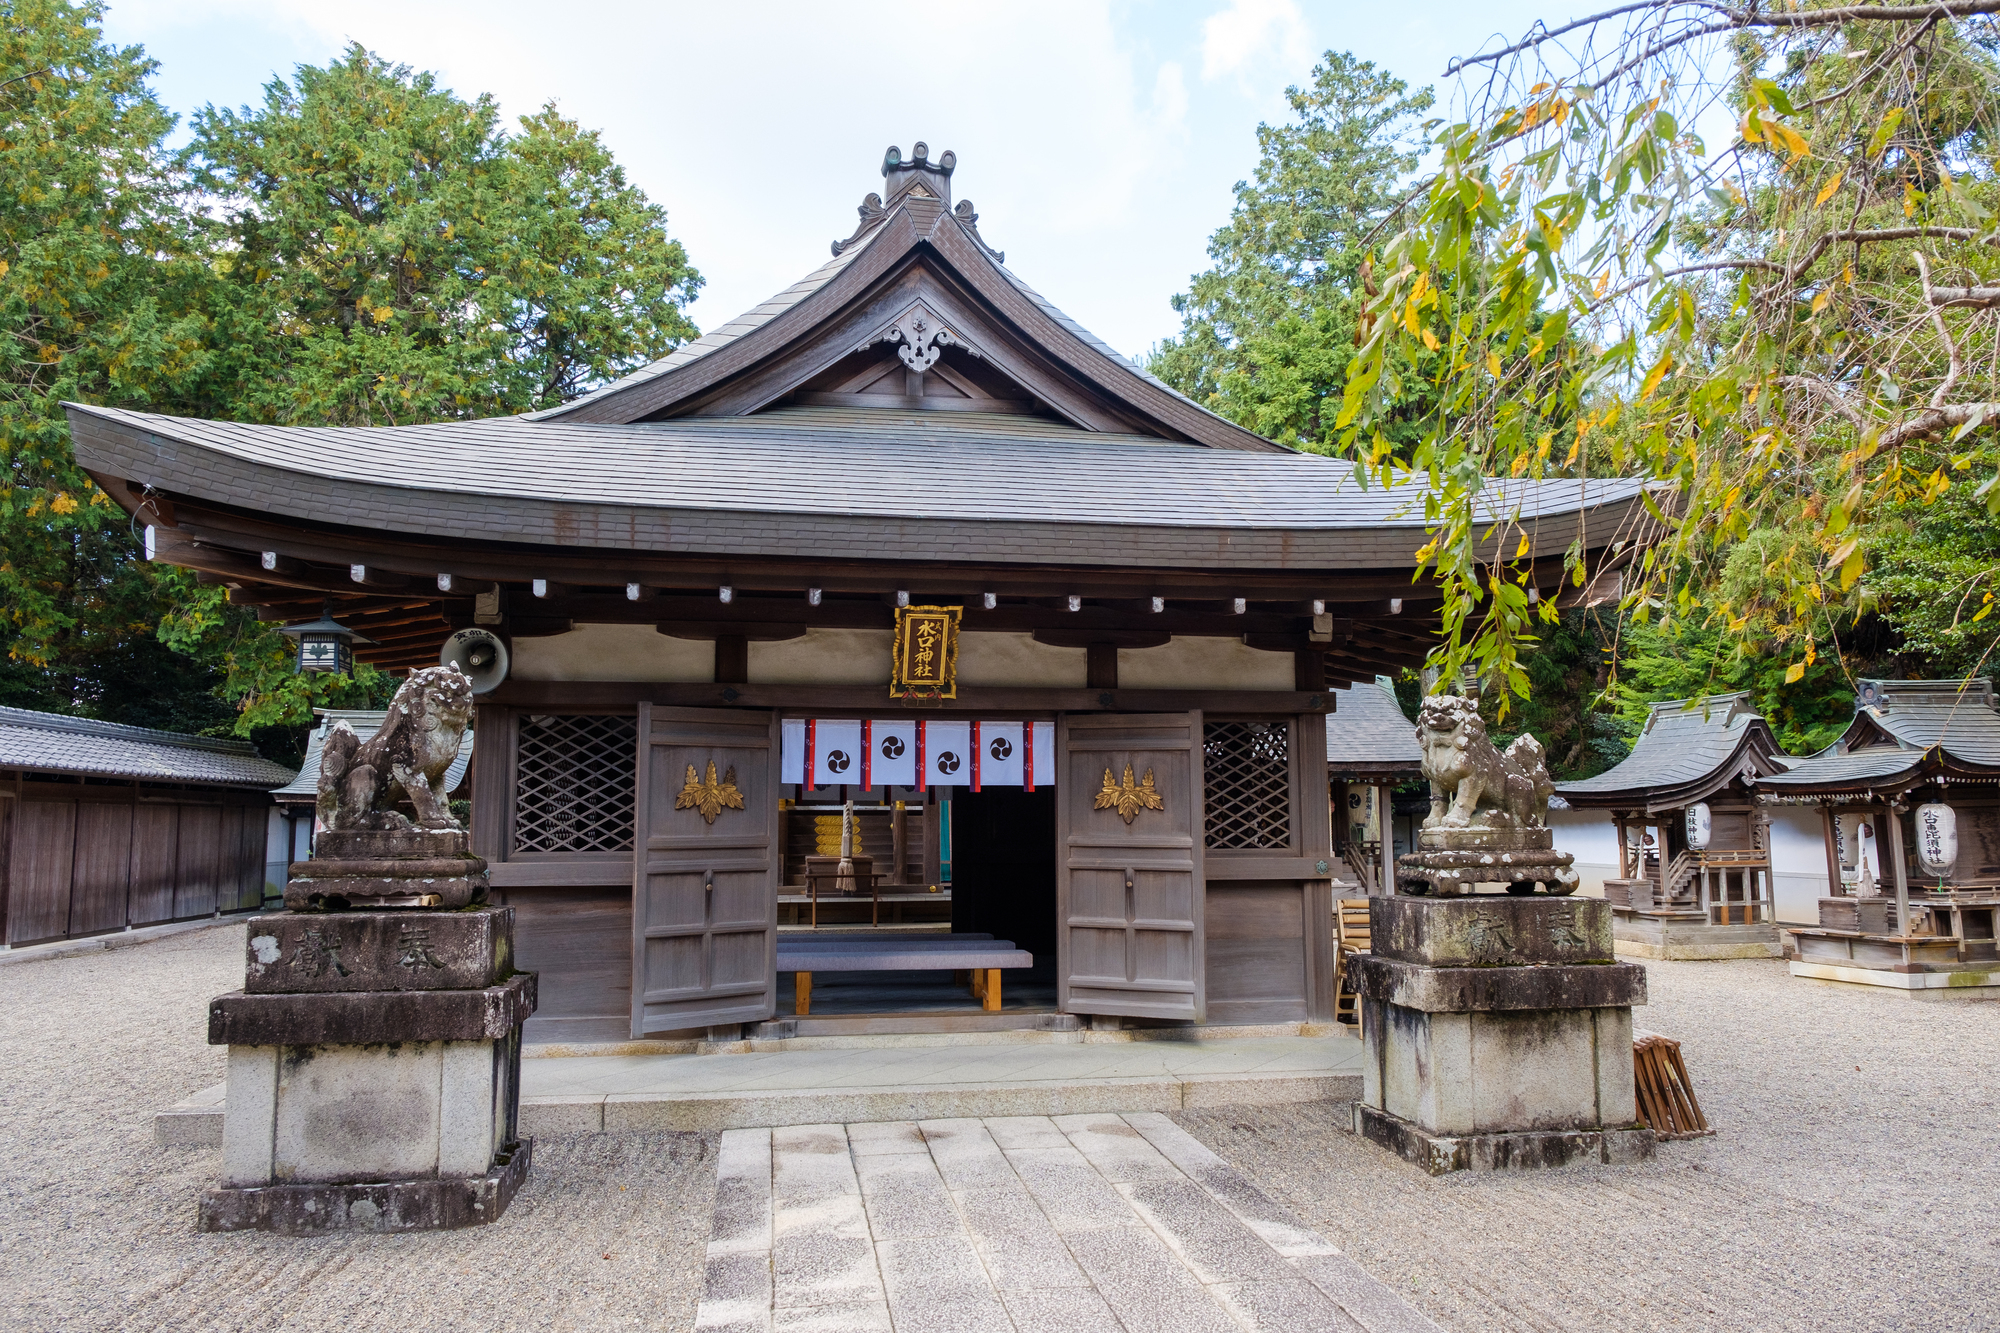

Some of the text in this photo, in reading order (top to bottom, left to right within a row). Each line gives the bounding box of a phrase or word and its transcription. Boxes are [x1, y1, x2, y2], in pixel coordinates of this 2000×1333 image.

[914, 620, 936, 677] 水口神社
[1687, 808, 1699, 844] 日枝神社
